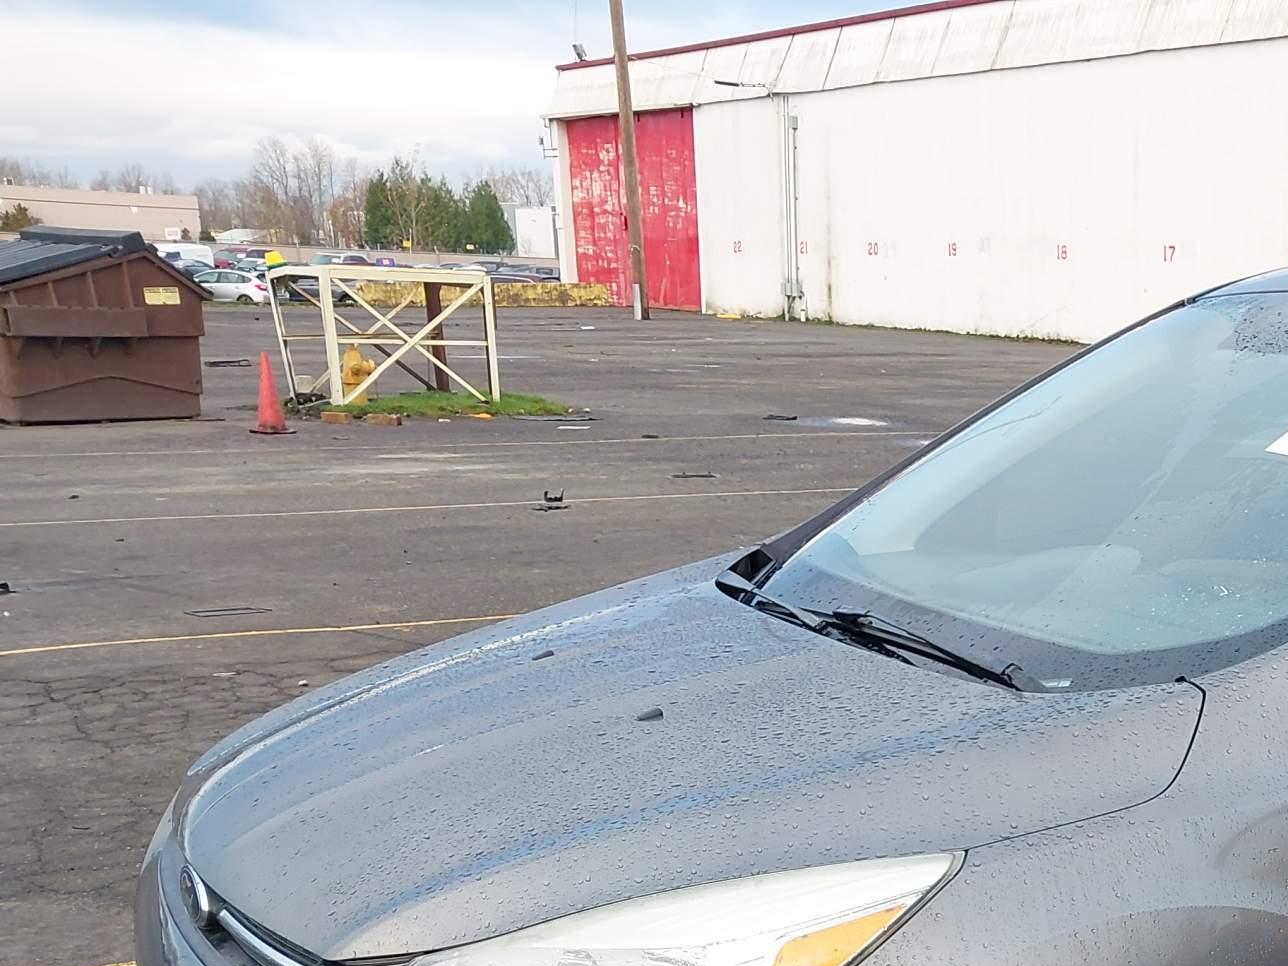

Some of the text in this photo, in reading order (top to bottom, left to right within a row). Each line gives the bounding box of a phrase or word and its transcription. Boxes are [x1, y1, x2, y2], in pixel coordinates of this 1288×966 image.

[732, 240, 743, 255] 22
[799, 240, 809, 255] 21
[867, 242, 879, 256] 20
[948, 242, 958, 257] 19
[1056, 244, 1068, 260] 18
[1163, 245, 1176, 262] 17
